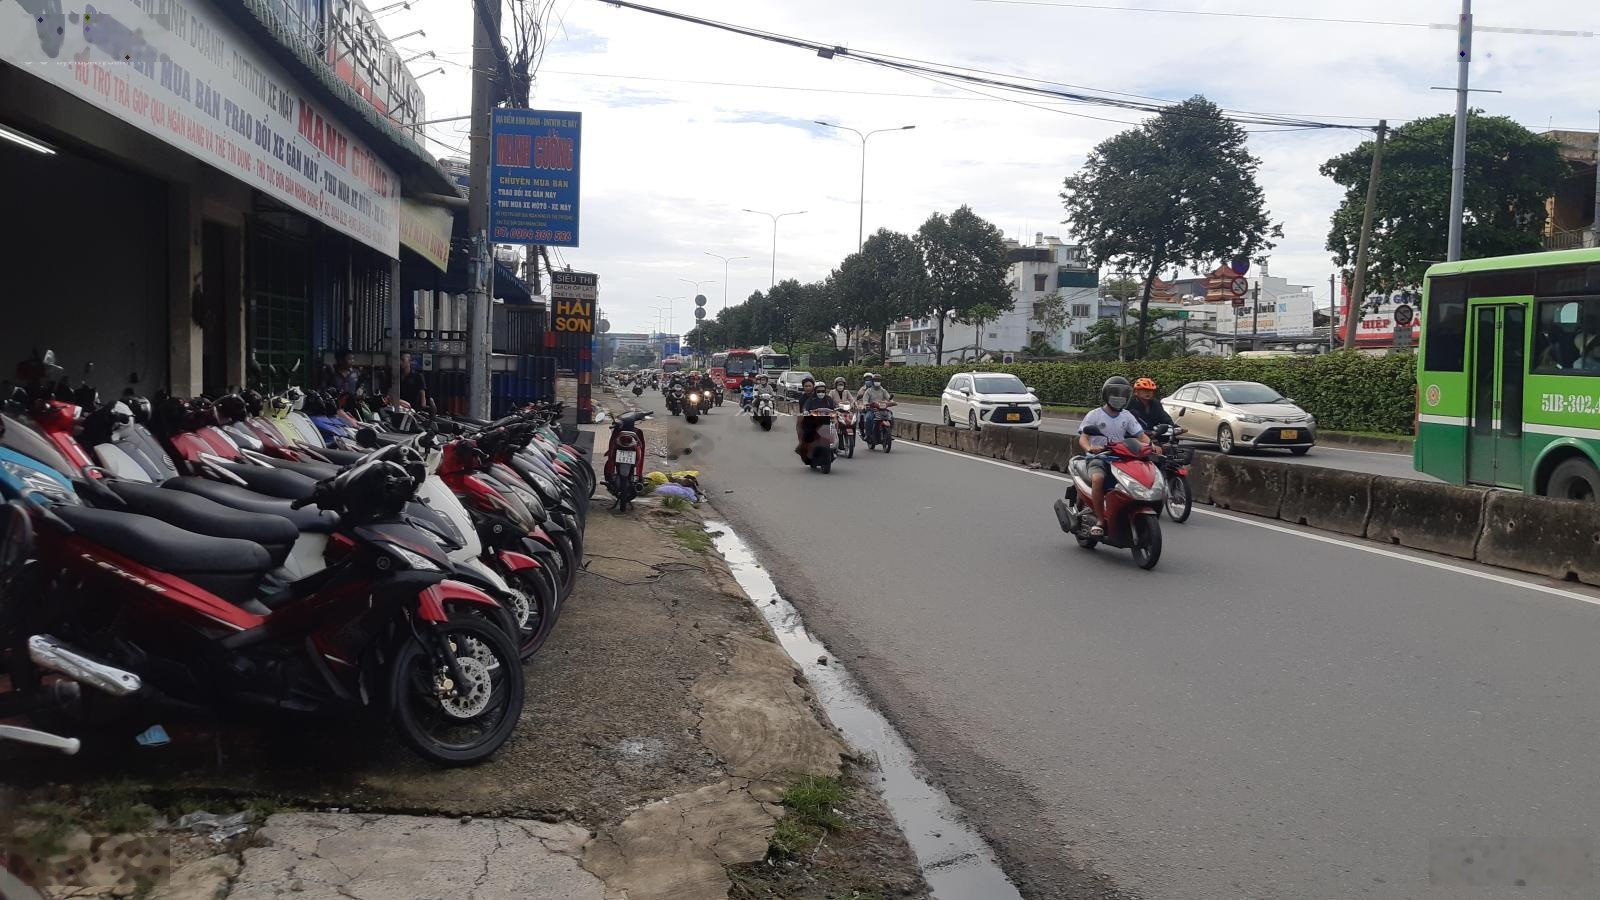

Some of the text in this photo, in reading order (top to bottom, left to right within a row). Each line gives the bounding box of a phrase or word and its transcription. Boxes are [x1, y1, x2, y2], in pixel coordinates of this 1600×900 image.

[267, 80, 277, 112] XE
[195, 77, 221, 121] BÁN
[224, 97, 253, 141] TRAO
[272, 132, 285, 162] XE
[303, 154, 319, 185] MÁY
[324, 170, 338, 197] THU
[533, 178, 550, 187] MUA
[498, 188, 513, 196] TRAO
[497, 200, 509, 208] THU
[556, 298, 591, 316] HẢI
[555, 317, 591, 333] SƠN
